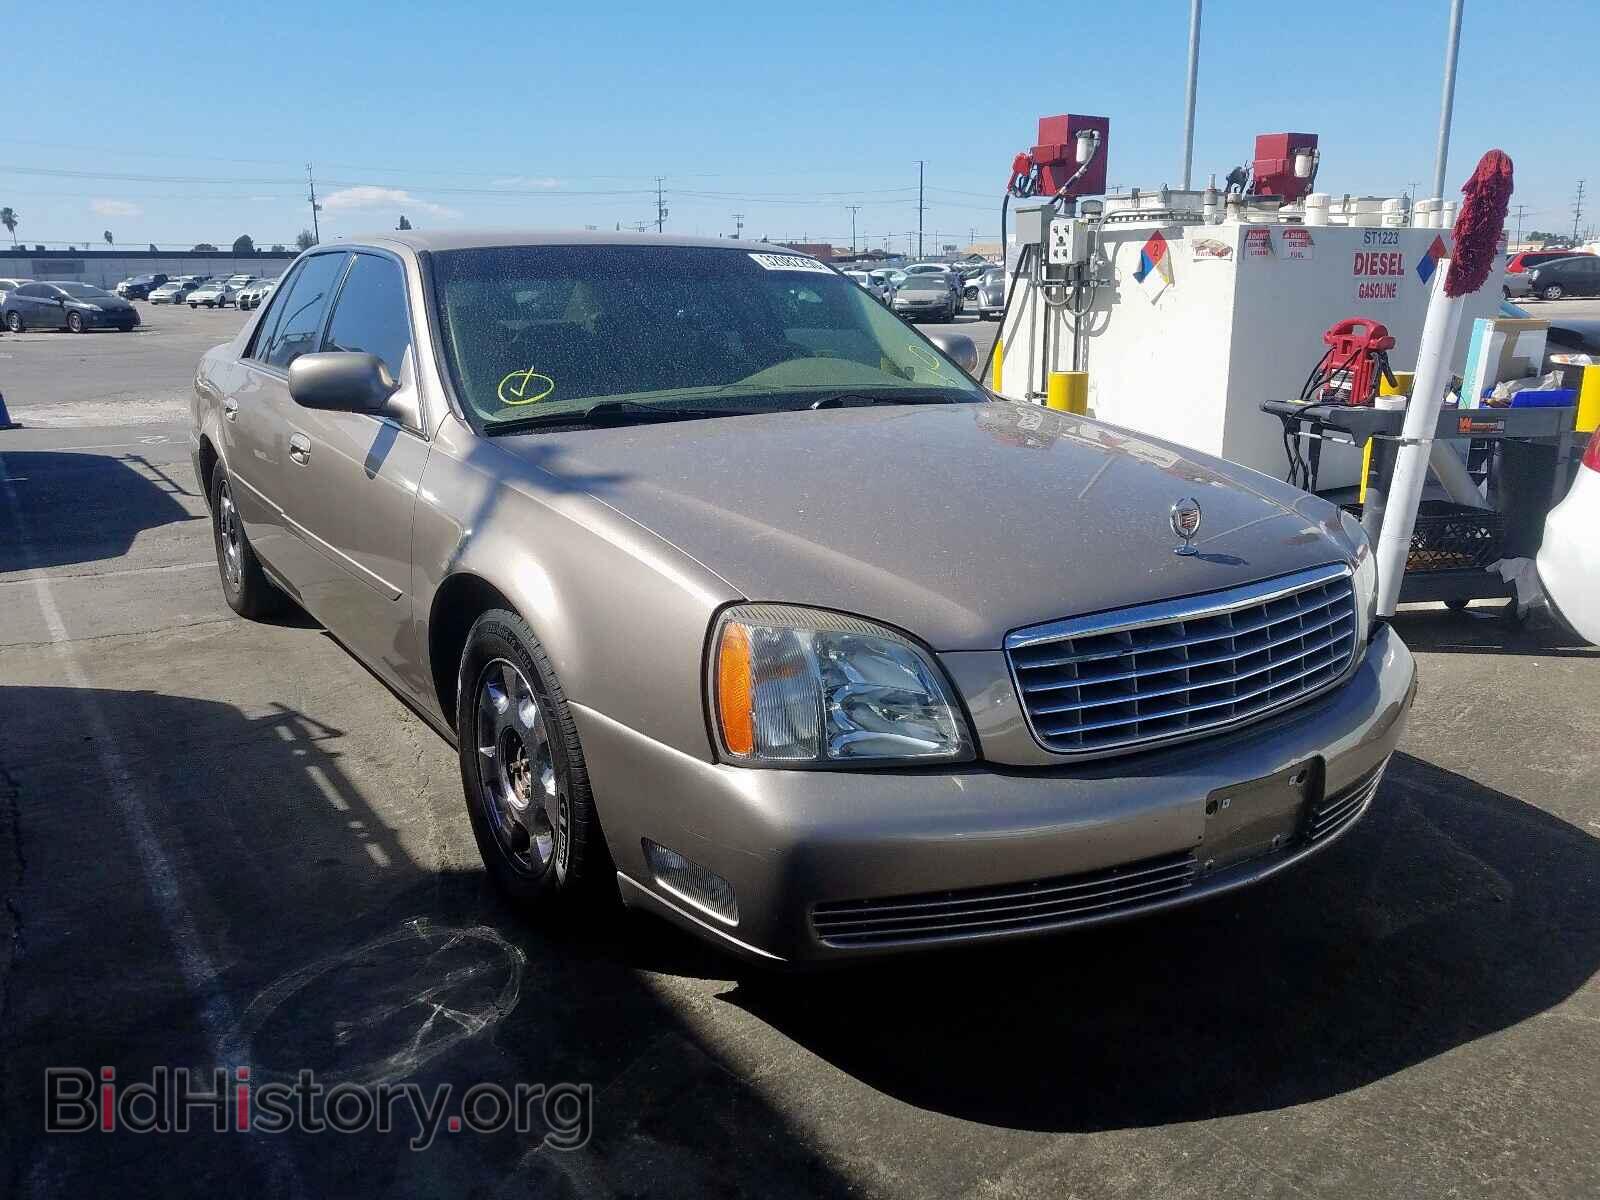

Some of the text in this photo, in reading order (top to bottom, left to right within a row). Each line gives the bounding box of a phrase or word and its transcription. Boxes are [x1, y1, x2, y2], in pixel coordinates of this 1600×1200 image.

[1363, 231, 1400, 245] ST1223
[1353, 252, 1405, 276] DIESEL
[1358, 283, 1397, 299] GASOLINE
